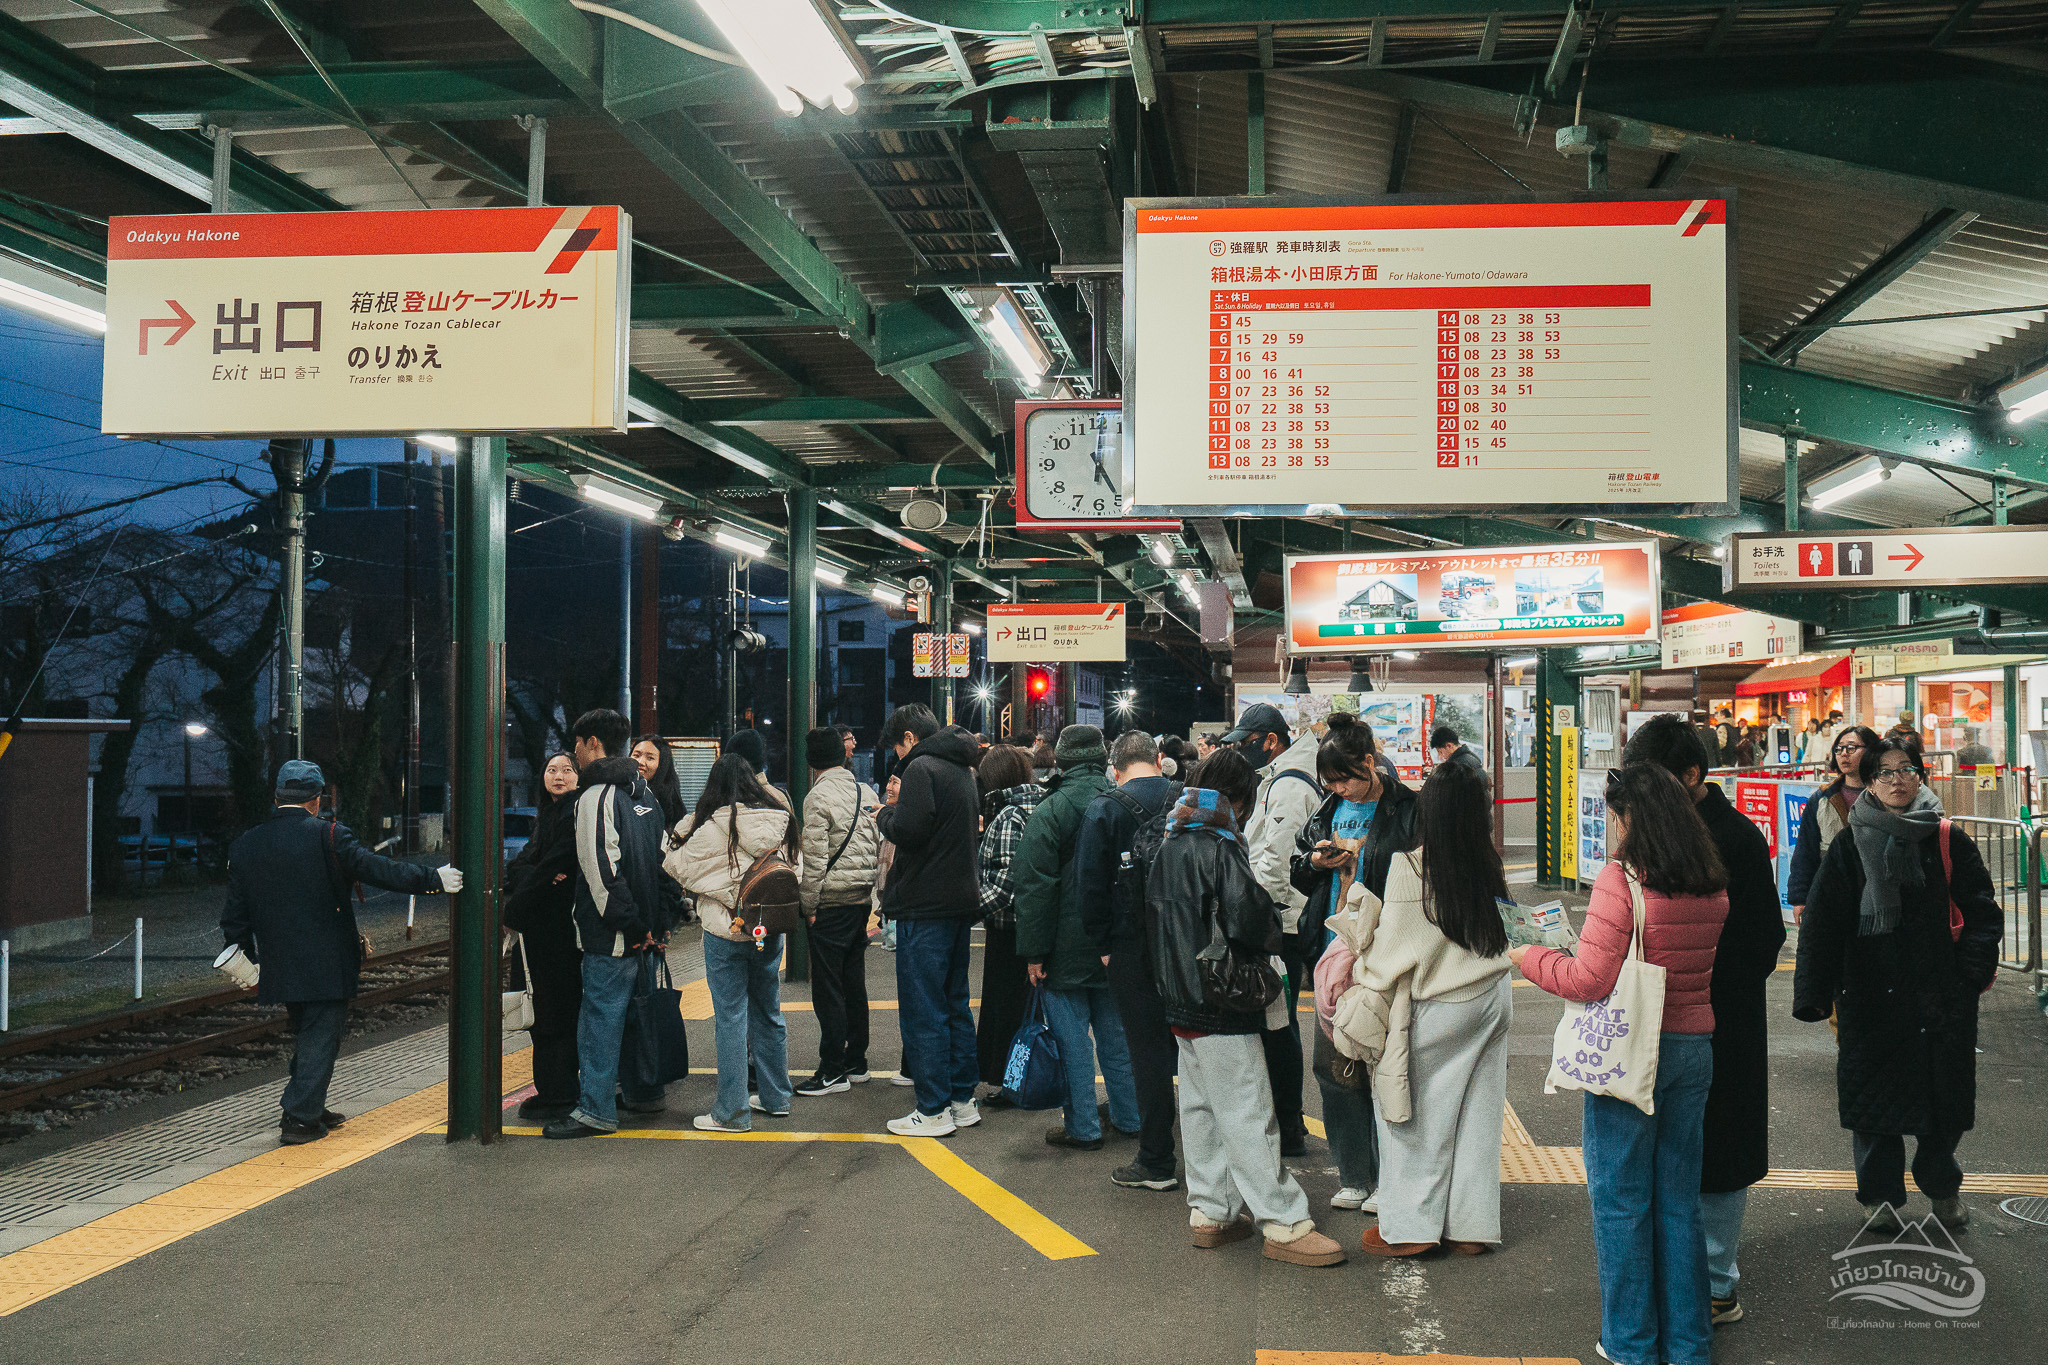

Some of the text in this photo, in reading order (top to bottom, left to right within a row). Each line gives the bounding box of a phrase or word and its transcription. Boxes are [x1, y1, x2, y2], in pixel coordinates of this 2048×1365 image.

[127, 228, 240, 245] Odakyu Hakone
[1230, 240, 1342, 254] 強羅駅 発車時刻表
[1211, 265, 1378, 283] 箱根湯本・小田原方面
[1389, 271, 1404, 281] For
[350, 288, 578, 316] 箱根登山ケーブルカー
[1214, 292, 1250, 302] 土・休日
[351, 317, 502, 331] Hakone Tozan Cablecar
[1221, 316, 1250, 327] 5 45
[1442, 313, 1559, 325] 14 08 23 38 53
[212, 297, 322, 355] 出口
[1220, 333, 1303, 344] 6 15 29 59
[1442, 331, 1559, 342] 15 08 23 38 53
[348, 344, 442, 369] のりかえ
[1220, 351, 1276, 361] 7 16 43
[1441, 348, 1559, 360] 16 08 23 38 53
[212, 363, 321, 381] Exit 出口 출구
[1219, 368, 1301, 379] 8 00 16 41
[1441, 366, 1533, 377] 17 08 23 38
[349, 374, 391, 383] Transfer
[1220, 385, 1329, 396] 9 07 23 36 52
[1441, 384, 1531, 395] 18 03 34 51
[1213, 403, 1329, 414] 10 07 22 38 53
[1441, 401, 1506, 413] 19 08 30
[1089, 418, 1107, 430] 12
[1212, 421, 1329, 431] 11 08 23 38 53
[1440, 419, 1506, 430] 20 02 40
[1070, 424, 1086, 436] 11
[1053, 438, 1071, 451] 10
[1212, 438, 1329, 449] 12 08 23 38 53
[1440, 436, 1506, 448] 21 15 45
[1043, 458, 1056, 471] 9
[1212, 455, 1328, 466] 13 08 23 38 53
[1440, 454, 1477, 465] 22 11
[1053, 481, 1066, 493] 8
[1073, 495, 1084, 507] 7
[1093, 499, 1105, 511] 6
[1752, 546, 1785, 557] お手洗
[1017, 626, 1047, 641] 出口
[1053, 624, 1115, 632] 箱根登山ケーブルカー
[1053, 638, 1079, 646] のりかえ
[1901, 645, 1938, 653] PASMO
[1556, 1055, 1627, 1086] HAPPY
